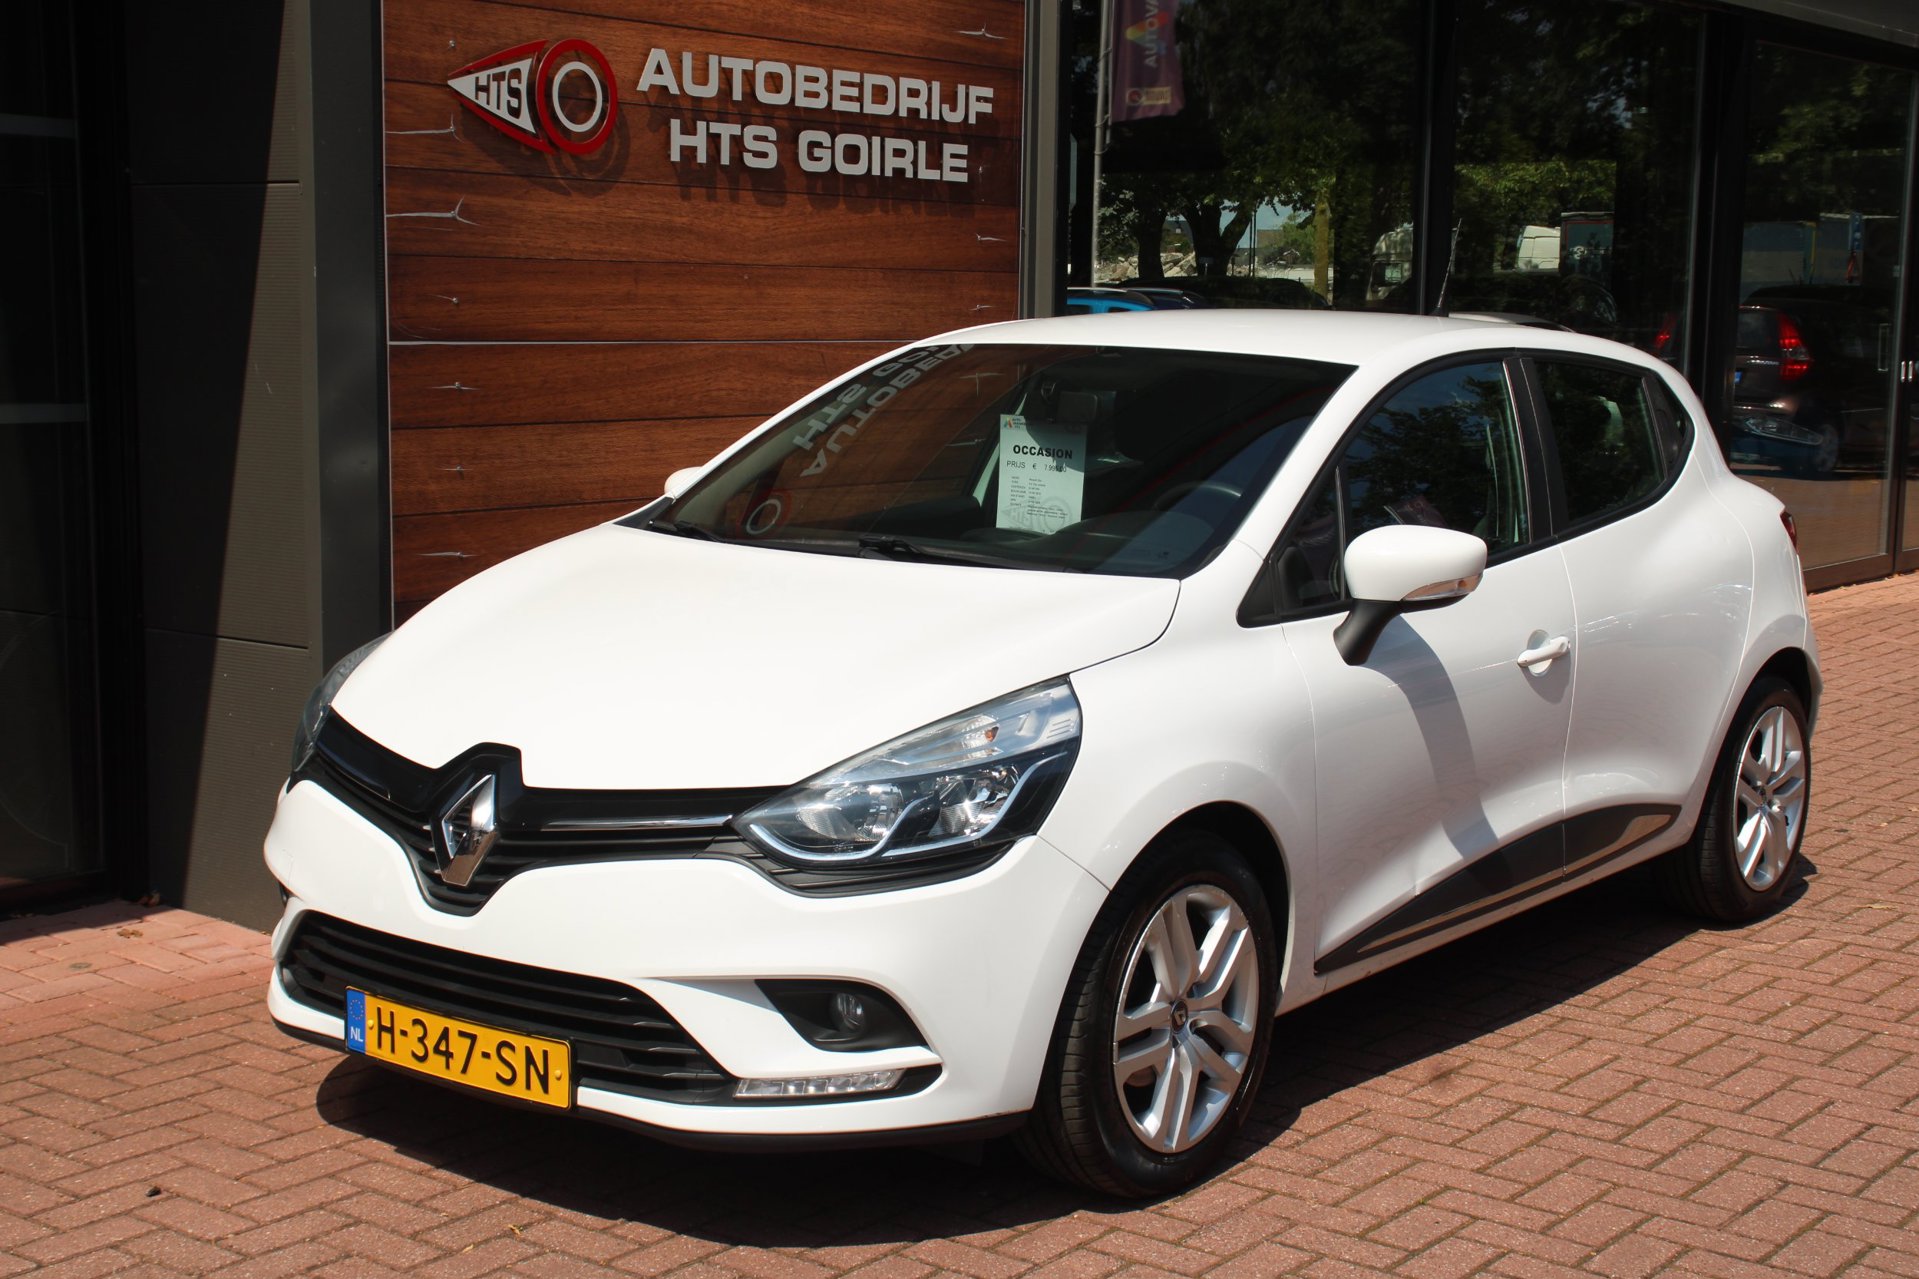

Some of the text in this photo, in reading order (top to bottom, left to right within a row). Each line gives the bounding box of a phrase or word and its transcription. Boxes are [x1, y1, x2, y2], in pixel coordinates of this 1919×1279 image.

[475, 68, 522, 119] HTS
[636, 48, 994, 124] AUTOBEDRIJF
[670, 119, 968, 183] HTS GOIRLE
[1006, 460, 1026, 469] PRIJS
[1013, 444, 1073, 459] OCCASION
[350, 1026, 364, 1043] NL
[376, 1006, 549, 1095] H-347-SN
